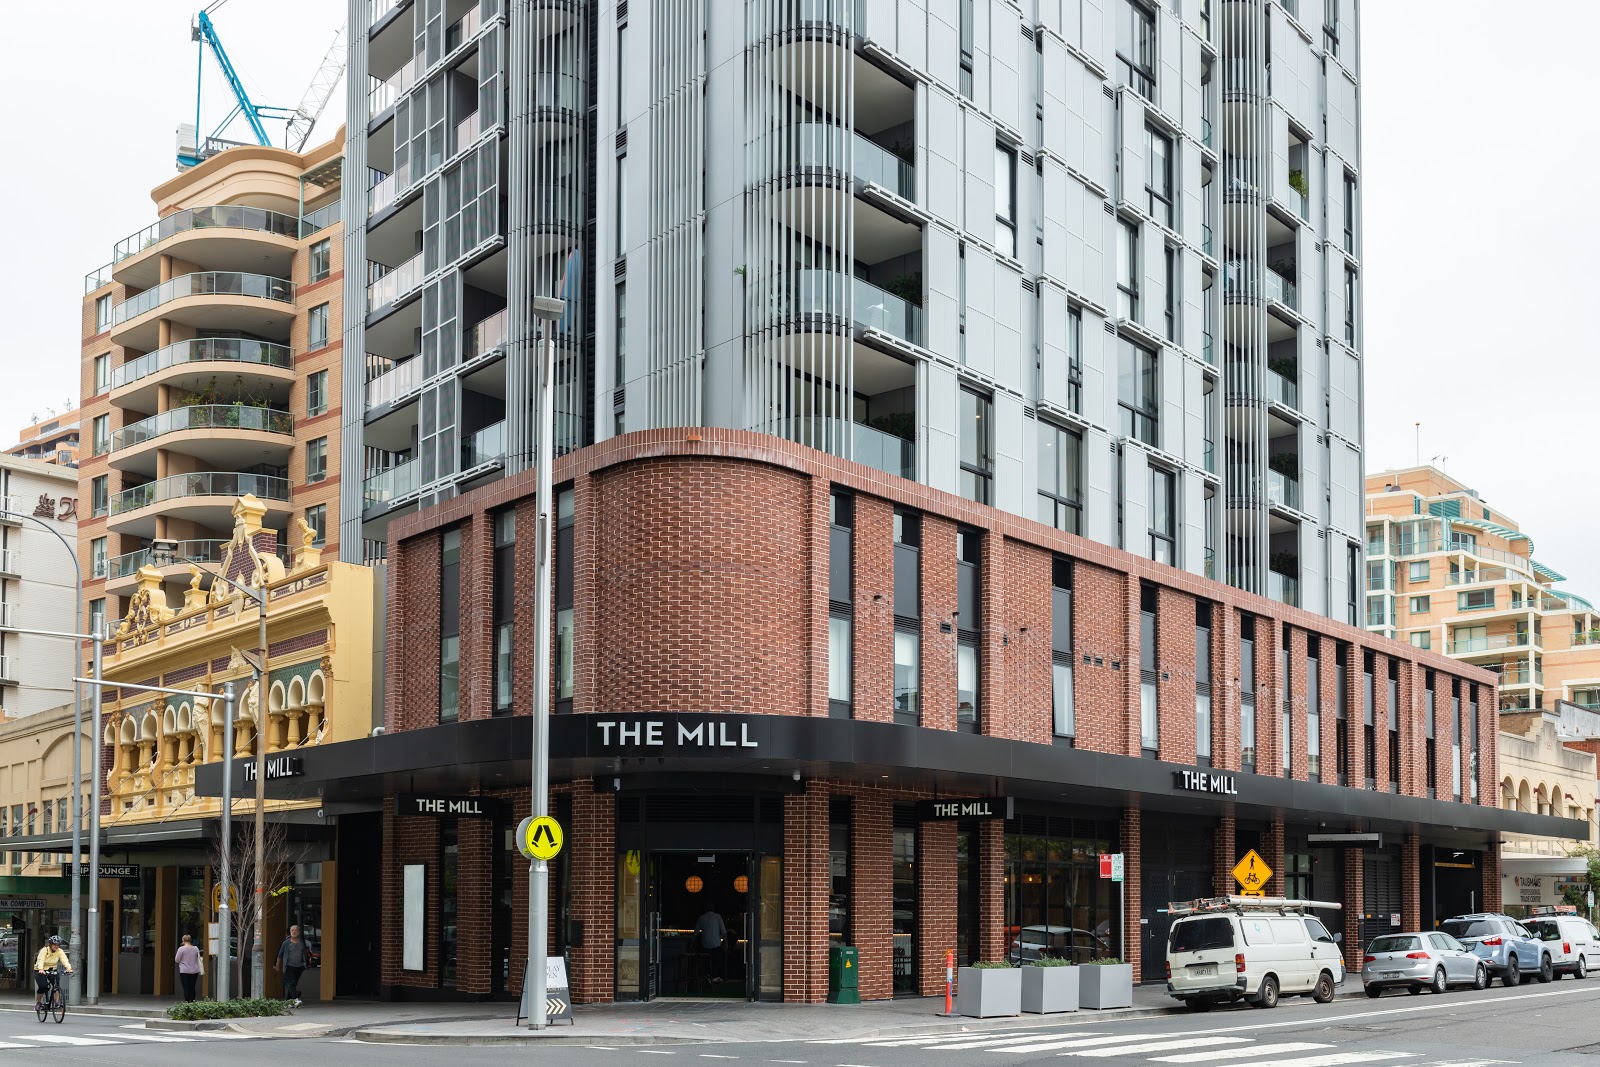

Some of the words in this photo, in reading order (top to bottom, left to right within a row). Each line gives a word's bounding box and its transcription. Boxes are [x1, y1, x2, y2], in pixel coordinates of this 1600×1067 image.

[597, 721, 664, 746] THE
[677, 721, 758, 747] MILL
[244, 761, 257, 781] TH
[267, 757, 292, 778] MILL
[1183, 770, 1207, 791] THE
[1210, 774, 1237, 794] MILL
[416, 799, 445, 812] THE
[449, 800, 482, 813] MILL
[934, 803, 959, 816] THE
[962, 802, 992, 815] MILL
[98, 867, 131, 875] OUNGE
